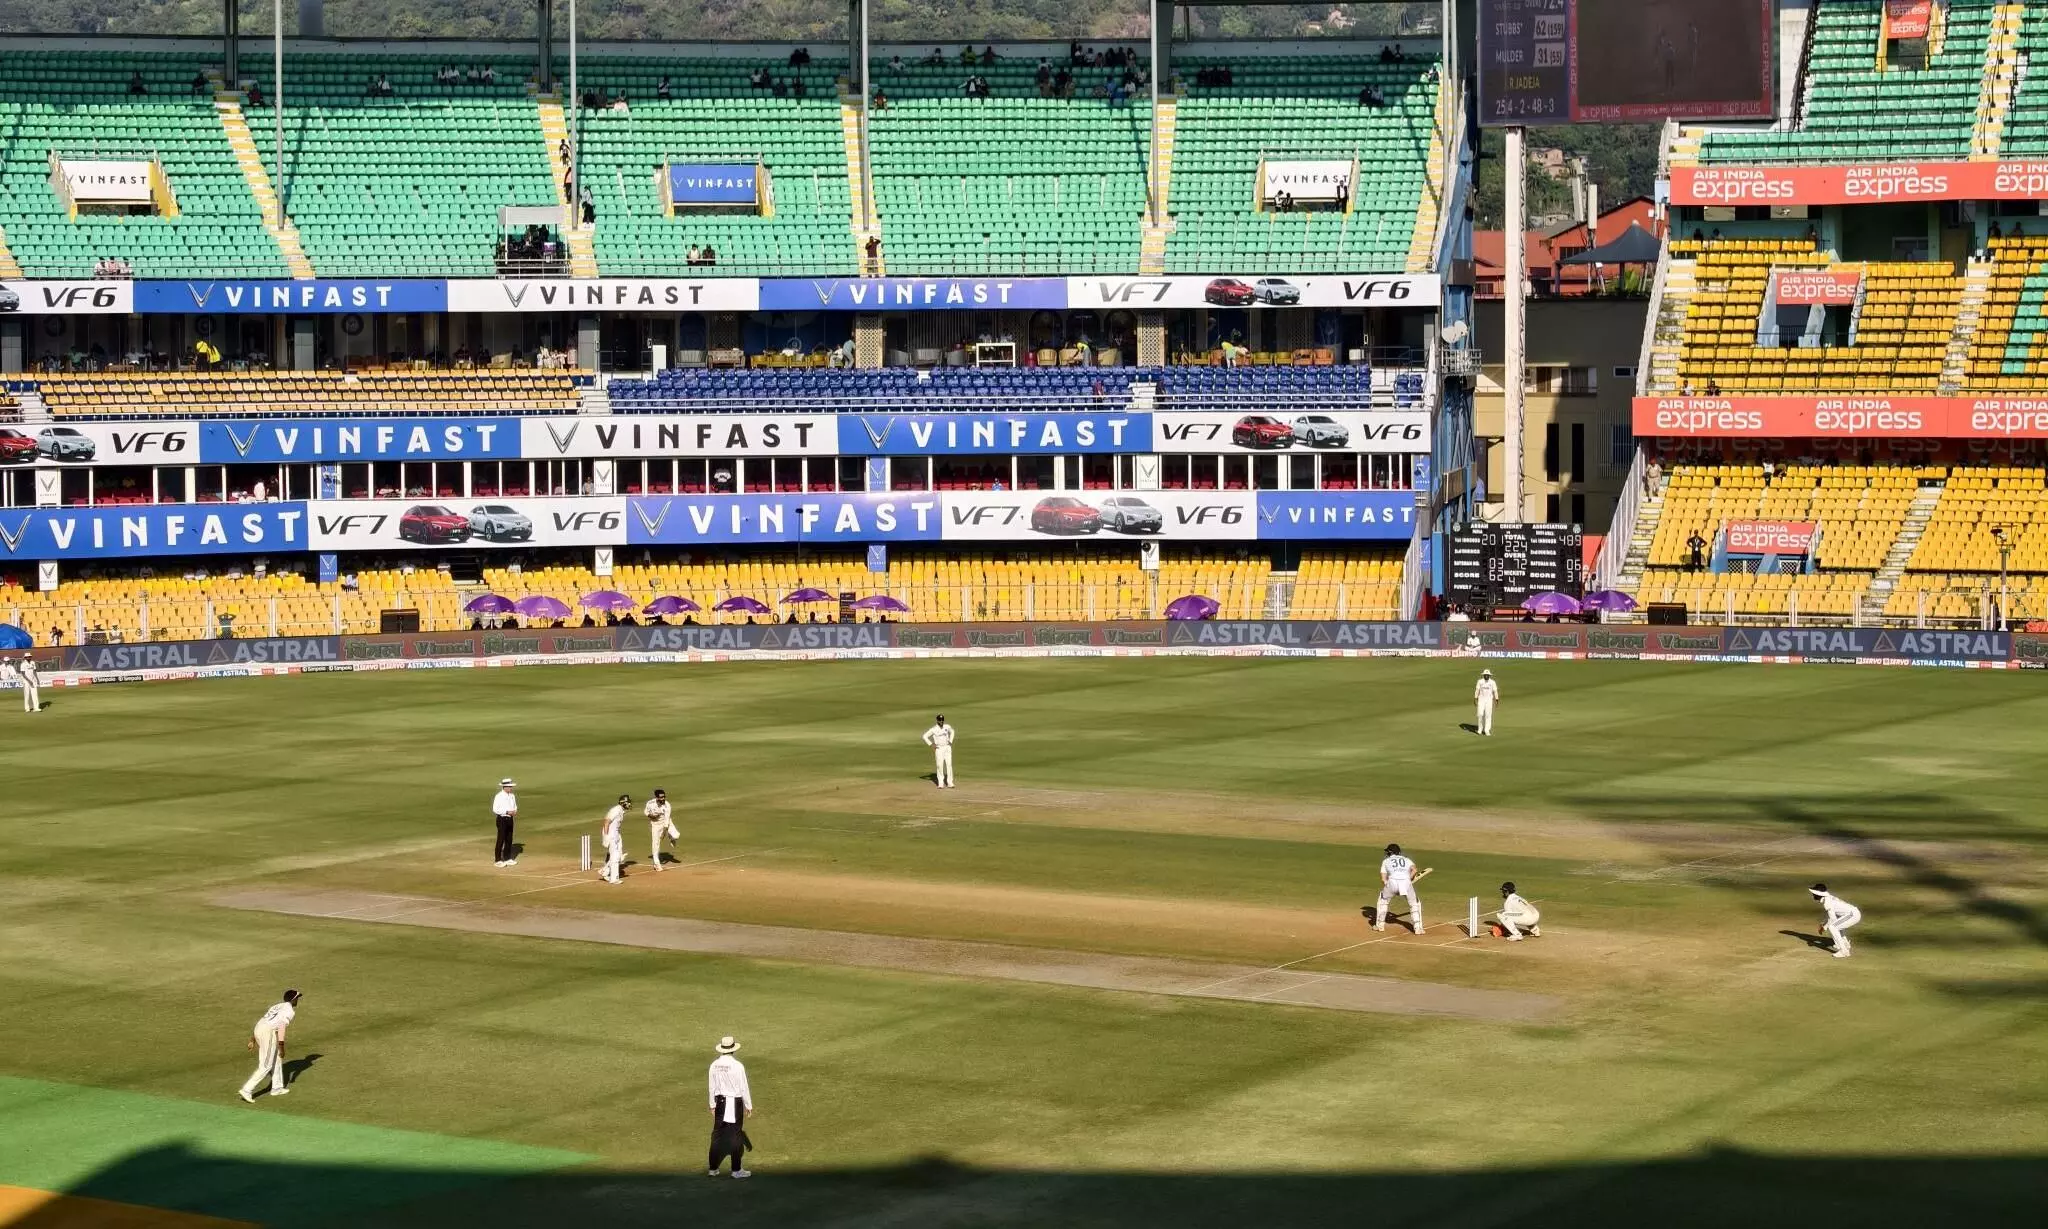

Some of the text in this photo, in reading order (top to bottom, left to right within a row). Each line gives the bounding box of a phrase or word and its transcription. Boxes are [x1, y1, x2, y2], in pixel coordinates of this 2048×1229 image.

[1536, 20, 1546, 36] 62
[1496, 48, 1524, 63] MULDER
[1538, 48, 1548, 64] 31
[1515, 76, 1540, 89] JADEJA
[1602, 106, 1620, 118] PLUS
[1694, 171, 1765, 180] AIR INDIA
[1847, 167, 1918, 177] AIR INDIA
[1997, 164, 2023, 173] AIR
[79, 175, 147, 185] VINFAST
[687, 178, 753, 188] VINFAST
[1283, 175, 1348, 184] VINFAST
[1845, 177, 1948, 199] express
[1692, 181, 1794, 202] express
[1782, 276, 1835, 284] AIR INDIA
[43, 286, 118, 307] VF6
[225, 285, 392, 307] VINFAST
[540, 285, 704, 305] VINFAST
[849, 283, 1013, 304] VINFAST
[1099, 282, 1173, 302] VF7
[1343, 281, 1412, 300] VF6
[1780, 284, 1856, 300] express
[1657, 400, 1732, 409] AIR INDIA
[1816, 400, 1891, 409] AIR INDIA
[1973, 400, 2048, 410] AIR INDIA
[1656, 411, 1762, 432] express
[1815, 411, 1922, 433] express
[275, 425, 497, 455] VINFAST
[595, 422, 814, 449] VINFAST
[910, 419, 1129, 448] VINFAST
[1162, 423, 1223, 440] VF7
[1363, 424, 1423, 440] VF6
[112, 431, 187, 454] VF6
[552, 511, 621, 532] VF6
[688, 502, 934, 534] VINFAST
[951, 506, 1021, 525] VF7
[1176, 505, 1244, 524] VF6
[1288, 506, 1414, 524] VINFAST
[48, 510, 300, 549] VINFAST
[317, 515, 388, 535] VF7
[1732, 524, 1787, 532] AIR INDIA
[1505, 541, 1528, 552] 224
[1559, 535, 1582, 546] 489
[1730, 532, 1810, 550] express
[1490, 558, 1503, 569] 03
[1513, 558, 1527, 570] 72
[1567, 558, 1581, 570] 06
[1490, 569, 1503, 581] 62
[1508, 576, 1515, 587] 4
[648, 628, 750, 650] ASTRAL
[786, 627, 888, 647] ASTRAL
[1198, 624, 1300, 644] ASTRAL
[1335, 624, 1438, 645] ASTRAL
[1516, 630, 1580, 648] Vimal
[1657, 633, 1720, 650] Vimal
[1756, 631, 1863, 652] ASTRAL
[233, 639, 337, 663] ASTRAL
[1900, 632, 2007, 656] ASTRAL
[96, 644, 198, 669] ASTRAL
[1507, 650, 1532, 658] ASTRAL
[1939, 659, 1964, 667] ASTRAL
[197, 670, 222, 678] ASTRAL
[222, 669, 248, 677] ASTRAL
[1391, 858, 1406, 868] 30
